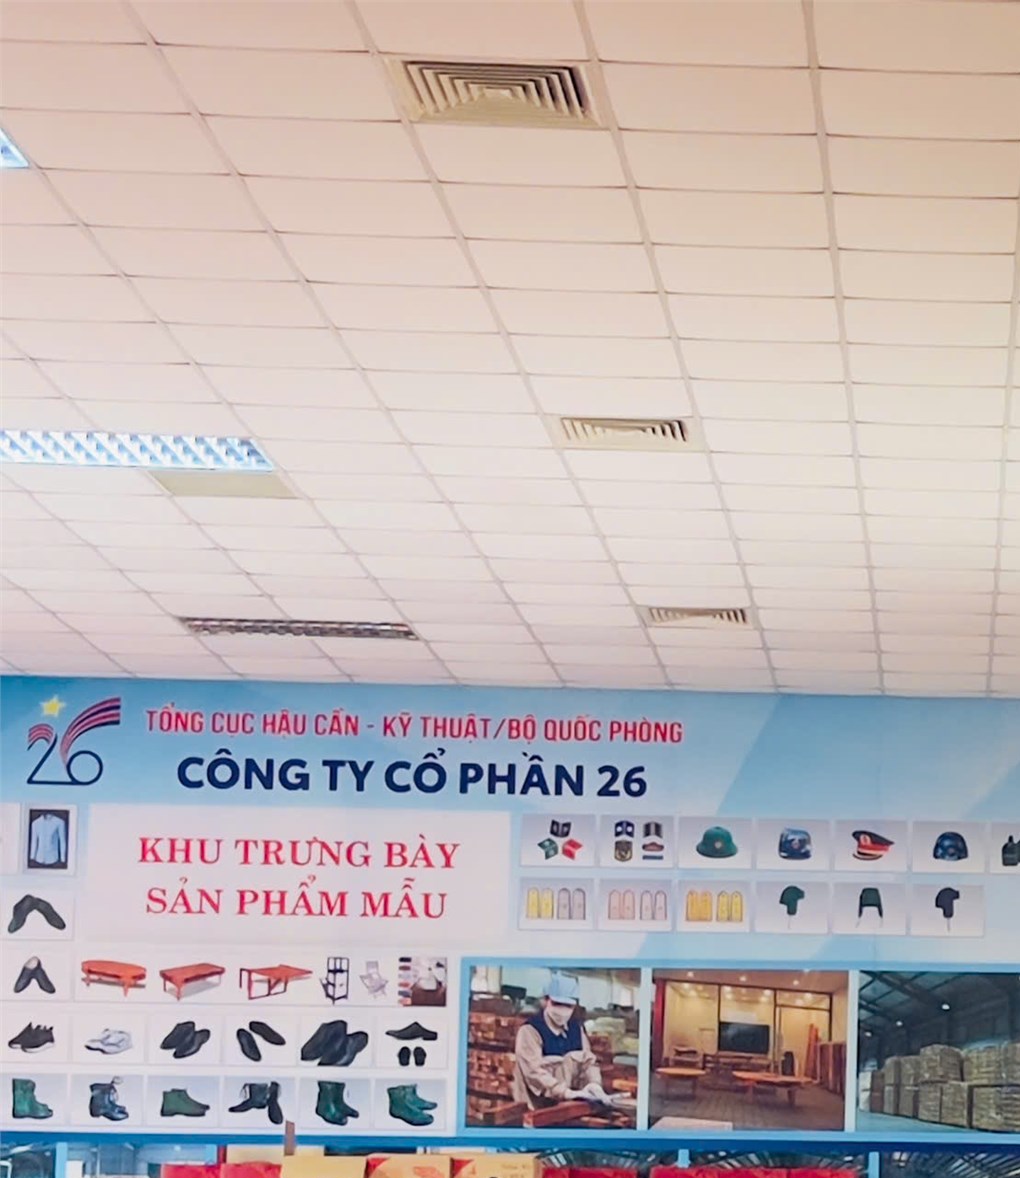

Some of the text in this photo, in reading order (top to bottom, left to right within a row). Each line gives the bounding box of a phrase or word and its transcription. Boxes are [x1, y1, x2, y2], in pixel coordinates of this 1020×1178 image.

[27, 697, 121, 786] 26
[146, 702, 204, 734] TỔNG
[211, 712, 255, 738] CỤC
[262, 709, 307, 739] HẬU
[544, 714, 601, 742] QUỐC
[609, 716, 682, 743] PHÒNG
[177, 748, 647, 798] CÔNG TY CỔ PHẦN 26
[138, 834, 461, 869] KHU TRƯNG BÀY
[146, 875, 448, 918] SẢN PHẨM MẪU
